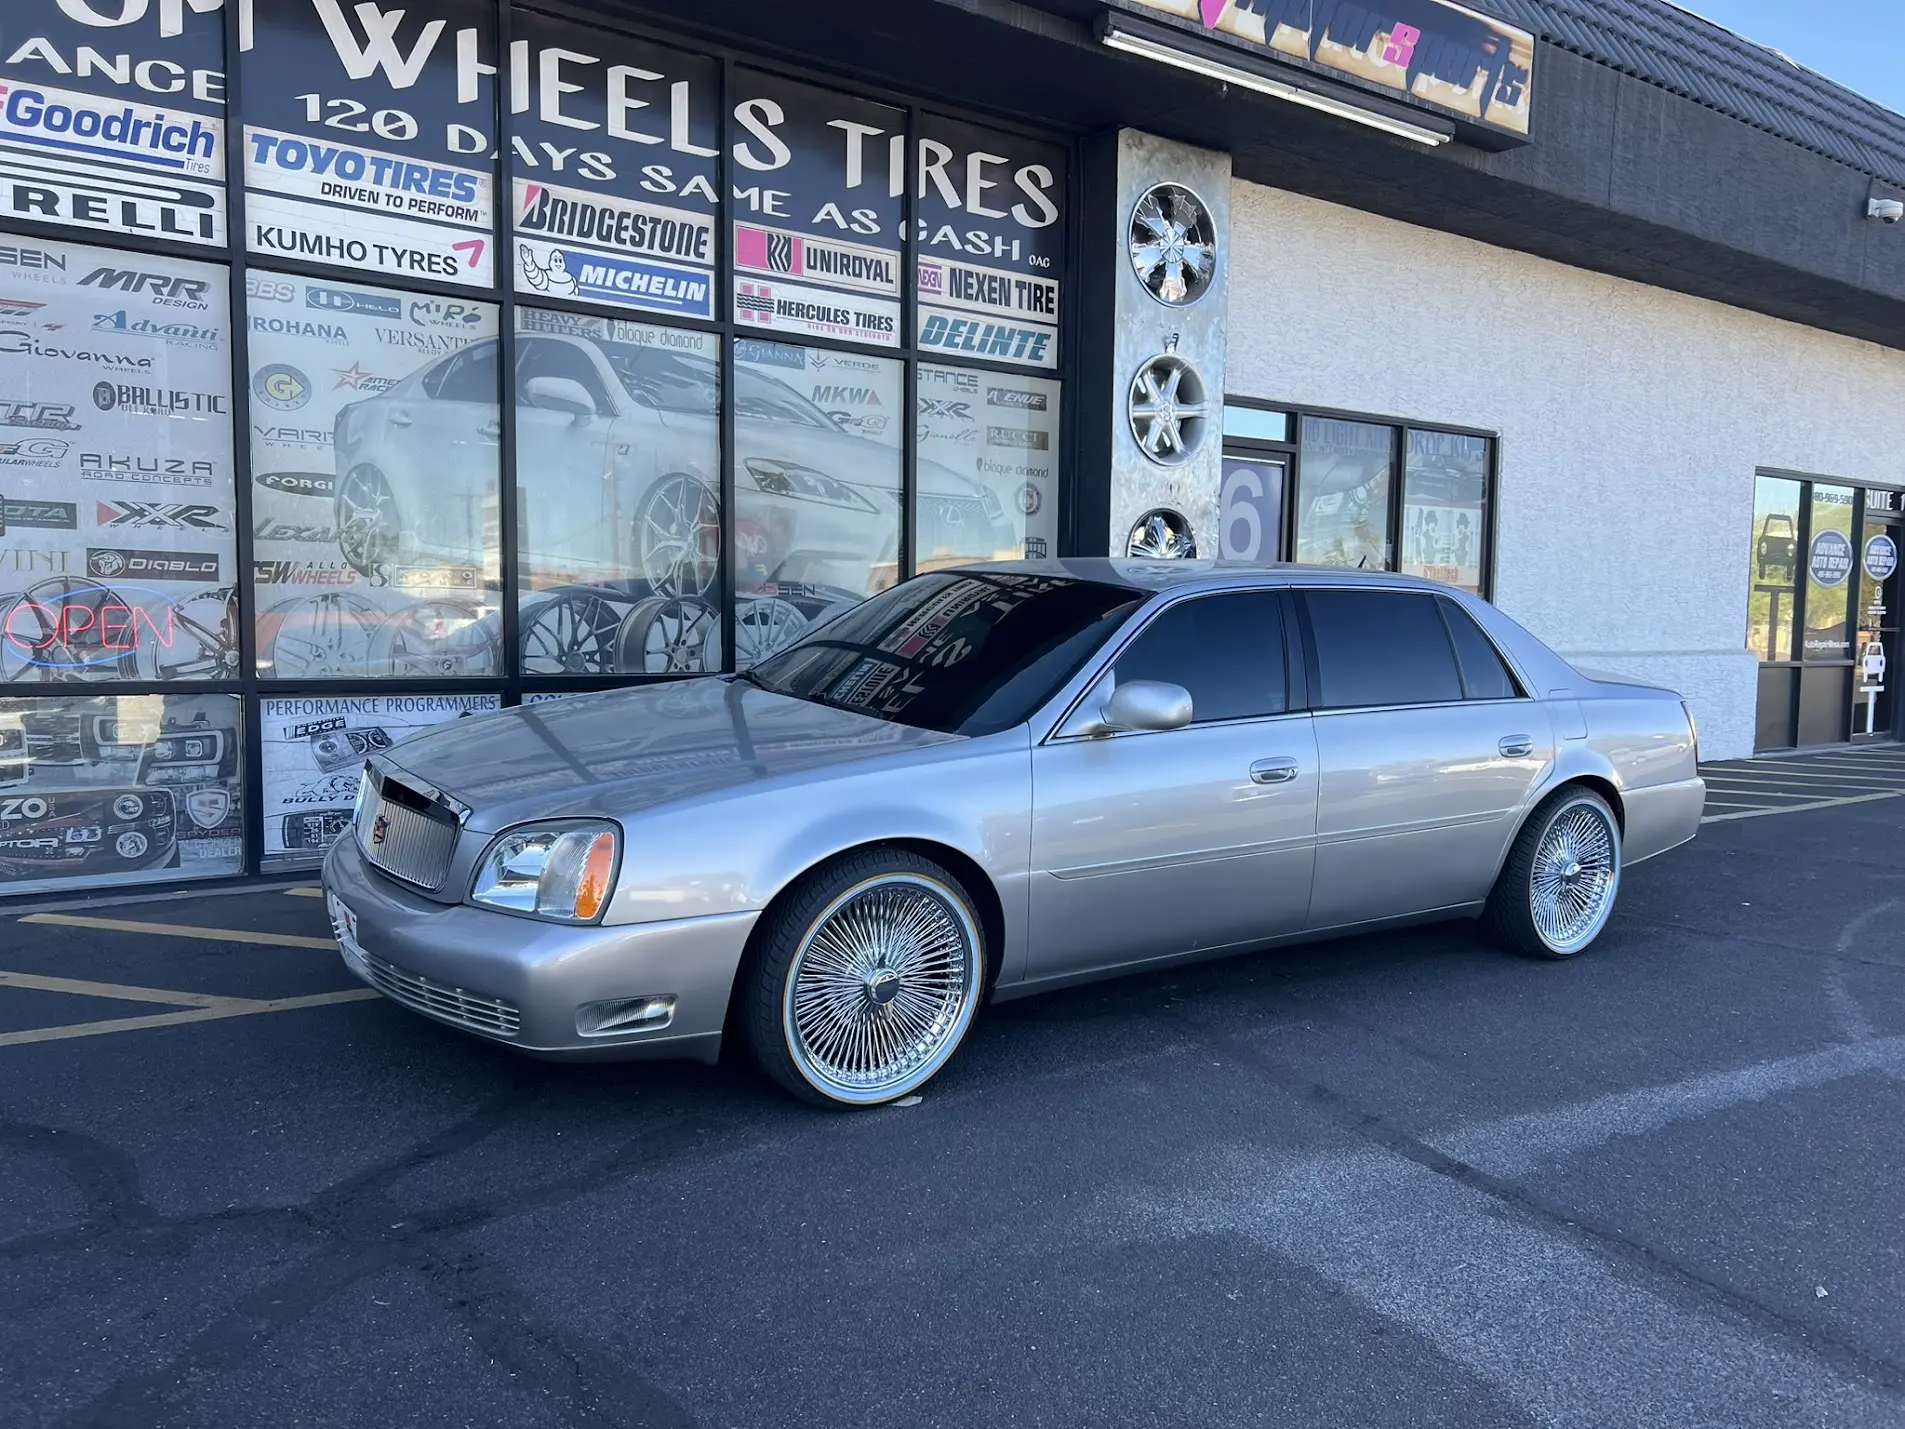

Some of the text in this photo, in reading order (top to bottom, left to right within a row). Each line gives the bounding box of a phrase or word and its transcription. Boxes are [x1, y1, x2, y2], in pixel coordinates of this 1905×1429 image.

[5, 37, 228, 104] ANCE
[0, 86, 215, 159] Goodrich
[312, 0, 791, 171] WHEELS
[826, 119, 1059, 229] TIRES
[184, 157, 210, 175] Tires
[250, 133, 479, 203] TOYO TIRES
[293, 93, 1051, 269] 120 DAYS SAME AS CASH OAC
[320, 181, 479, 223] DRIVEN TO PERFORM
[518, 184, 710, 260] BRIDGESTONE
[255, 224, 459, 277] KUMHO TYRES
[805, 245, 895, 285] UNIROYAL
[12, 270, 67, 285] WHEELS
[76, 267, 211, 302] MRR
[578, 264, 707, 302] MICHELIN
[949, 267, 1055, 315] NEXEN TIRE
[152, 296, 209, 311] DESIGN
[521, 307, 583, 326] HEAVY
[776, 298, 894, 333] HERCULES TIRES
[92, 310, 219, 341] Advanti
[253, 316, 348, 340] ROHANA
[918, 315, 1052, 362] DELINTE
[0, 330, 153, 368] Giovanna
[165, 339, 219, 351] RACING
[833, 358, 880, 371] VERDE
[917, 367, 979, 388] STANCE
[117, 384, 227, 416] BALLISTIC
[811, 384, 870, 406] MKW
[80, 453, 213, 476] AKUZA
[131, 472, 213, 486] CONCEPTS
[1219, 468, 1263, 562] 6
[1866, 488, 1894, 511] SUITE
[128, 558, 217, 573] DIABLO
[6, 603, 175, 649] OPEN
[266, 696, 497, 716] PERFORMANCE PROGRAMMERS
[295, 719, 346, 736] EDGE
[282, 794, 338, 804] BULLY
[176, 827, 241, 839] SPYDER
[199, 847, 242, 859] DEALER
